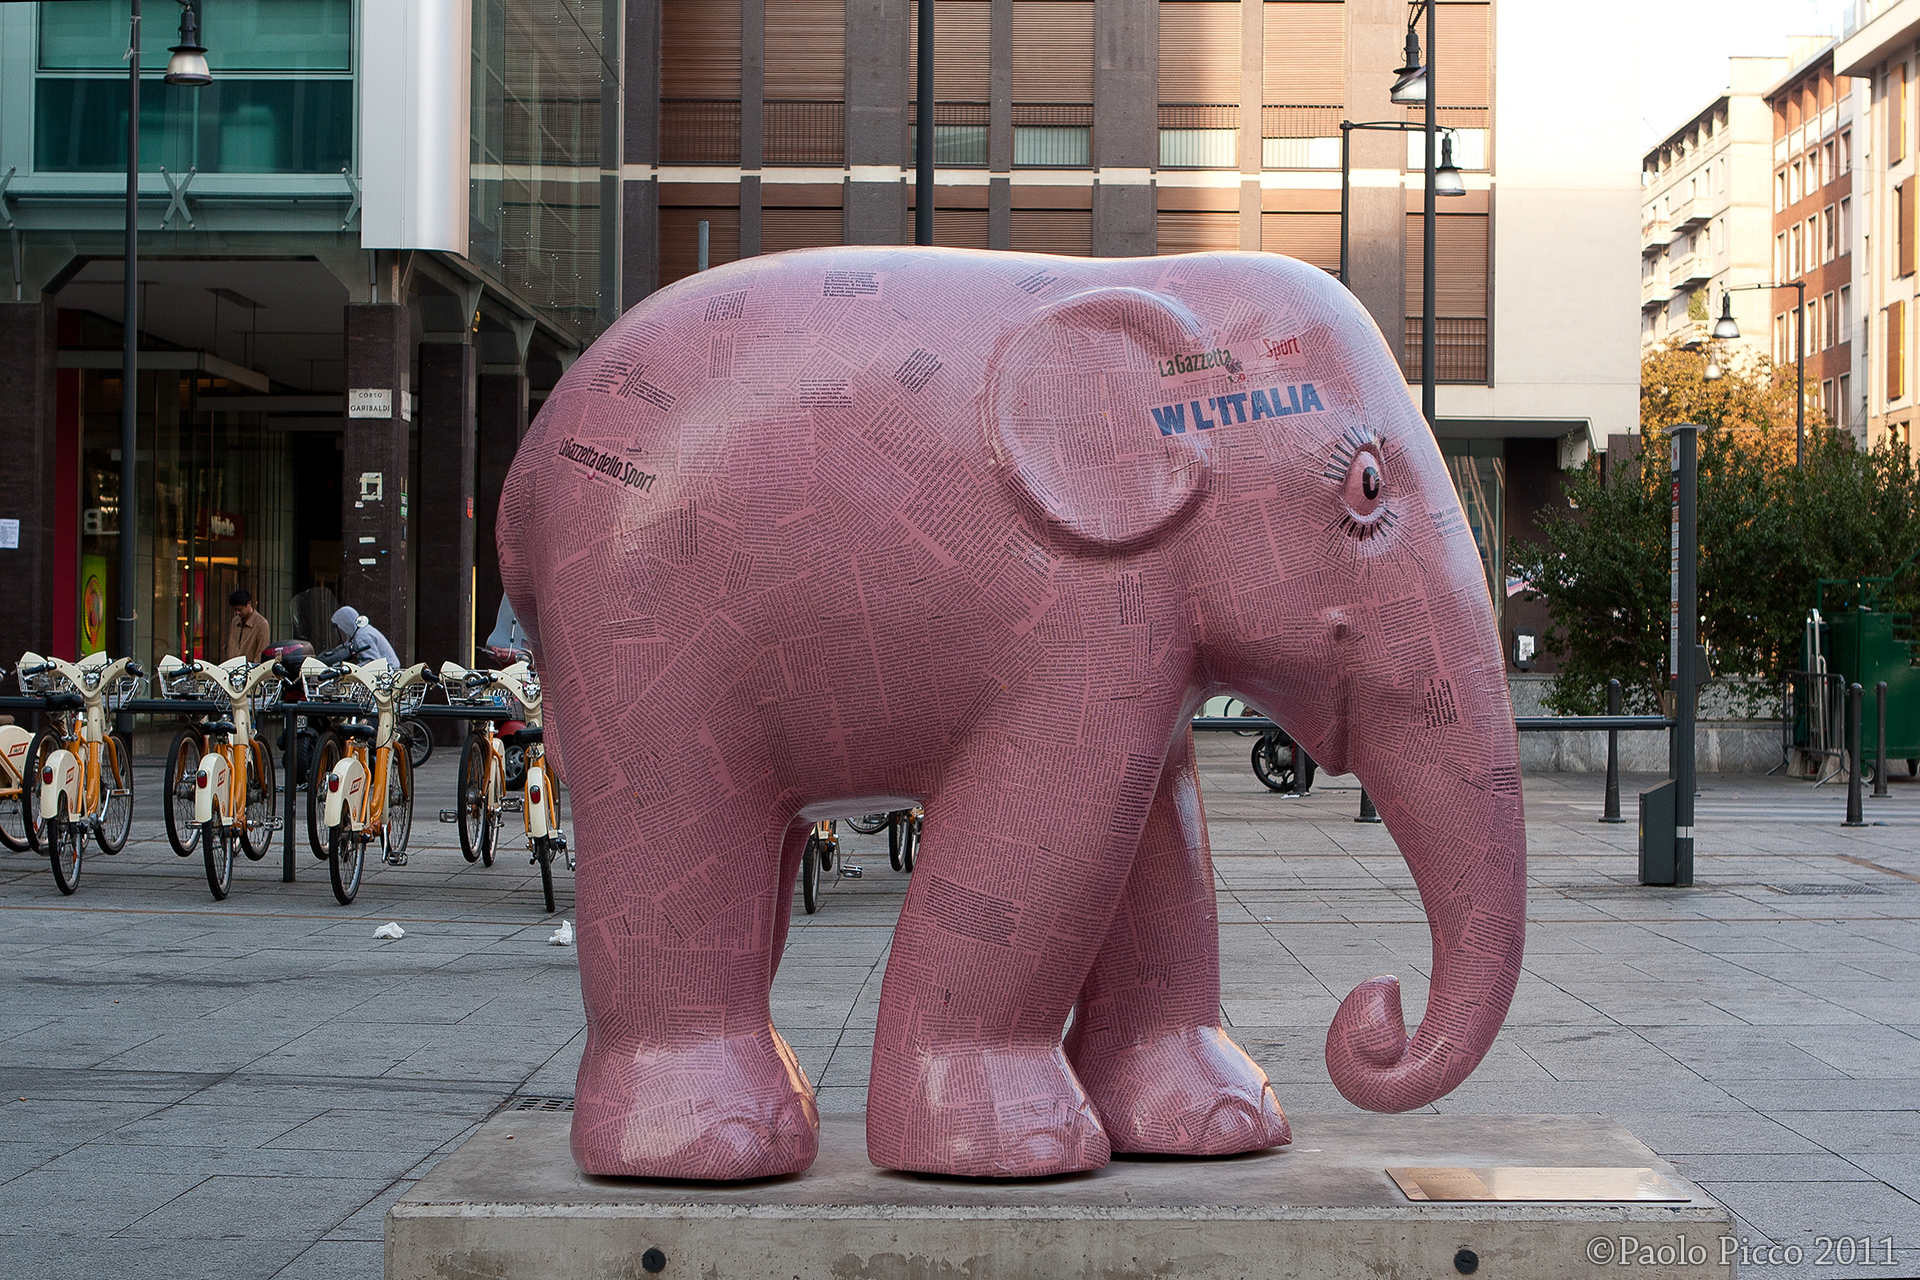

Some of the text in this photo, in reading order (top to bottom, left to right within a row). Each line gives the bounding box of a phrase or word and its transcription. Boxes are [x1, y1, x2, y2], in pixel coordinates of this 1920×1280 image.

[1262, 335, 1300, 360] Sport
[1151, 384, 1324, 436] W L'ITALIA
[595, 452, 623, 478] dello
[619, 462, 656, 493] Sport
